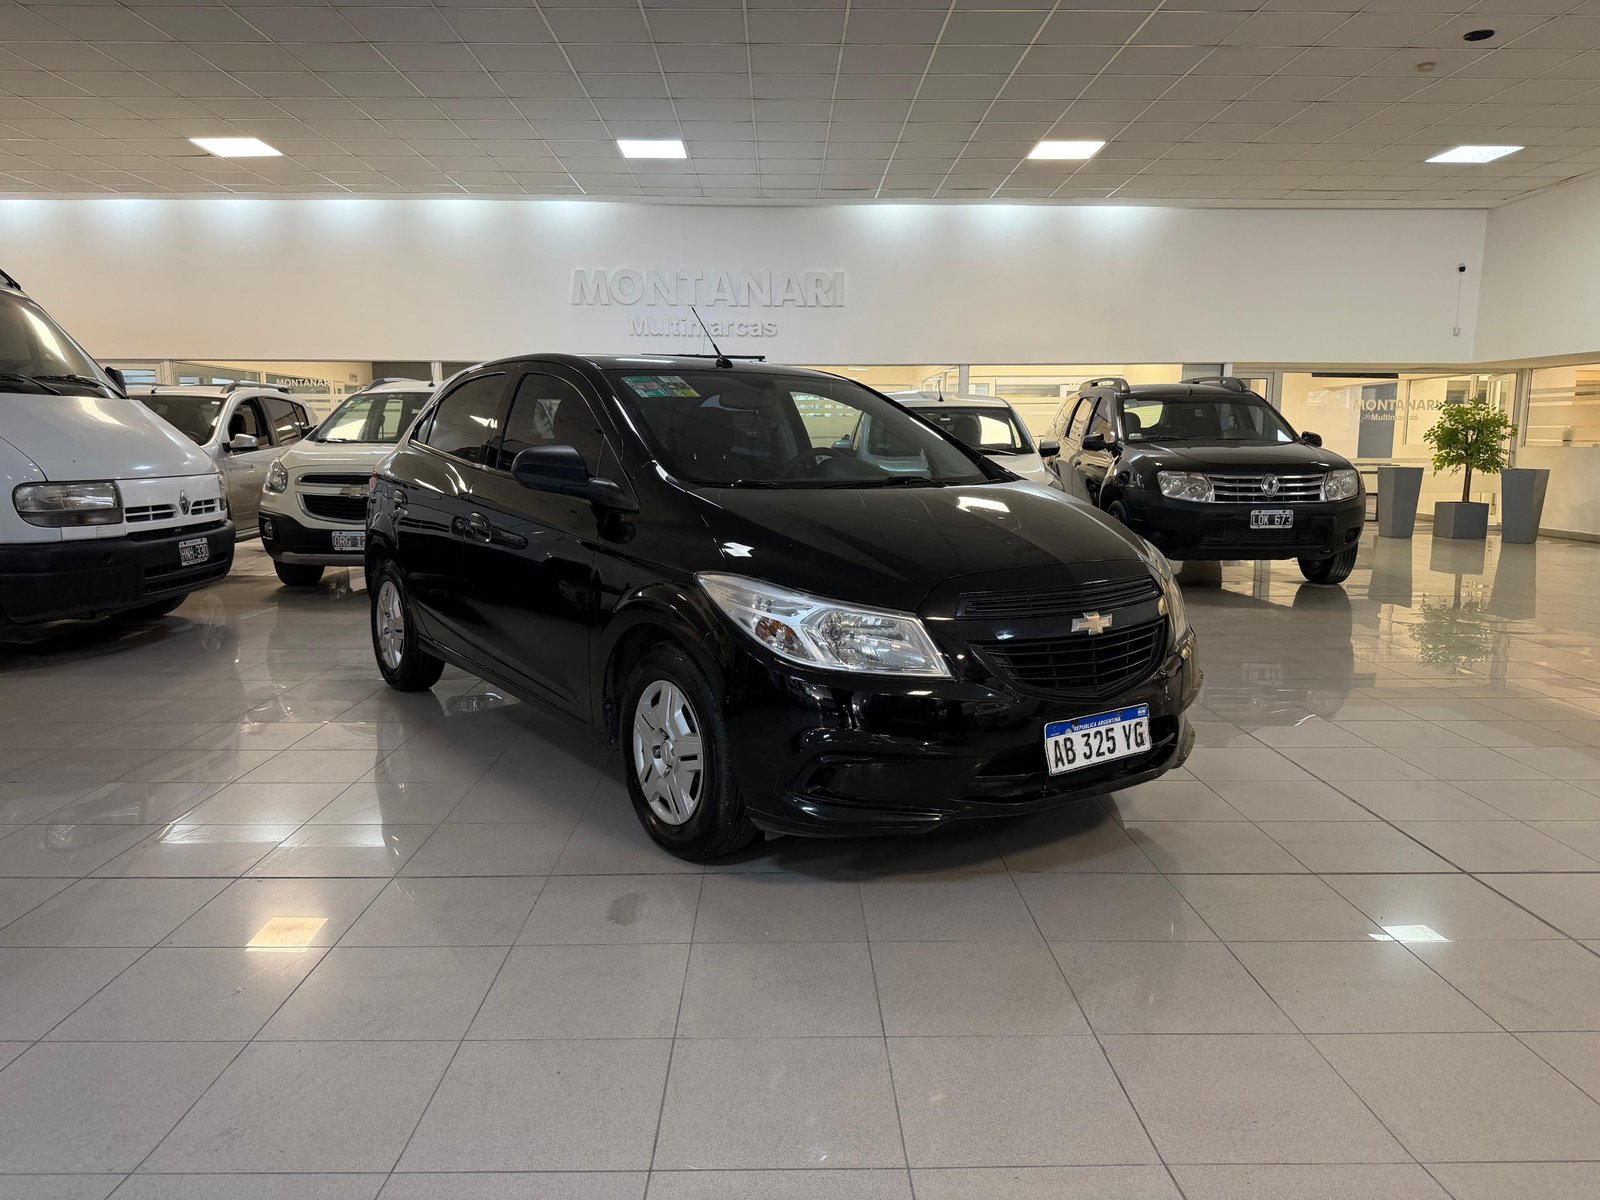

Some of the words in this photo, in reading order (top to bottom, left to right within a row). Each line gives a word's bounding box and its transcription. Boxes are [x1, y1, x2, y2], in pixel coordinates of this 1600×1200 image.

[571, 269, 846, 308] MONTANARI
[628, 316, 778, 338] Multimarcas
[1371, 413, 1418, 421] Multimarcas
[1274, 514, 1292, 525] 673
[334, 536, 352, 547] ORG
[1098, 716, 1121, 727] ARGENTINA
[1053, 737, 1077, 769] AB
[1081, 727, 1117, 760] 325
[1122, 721, 1146, 751] YG
